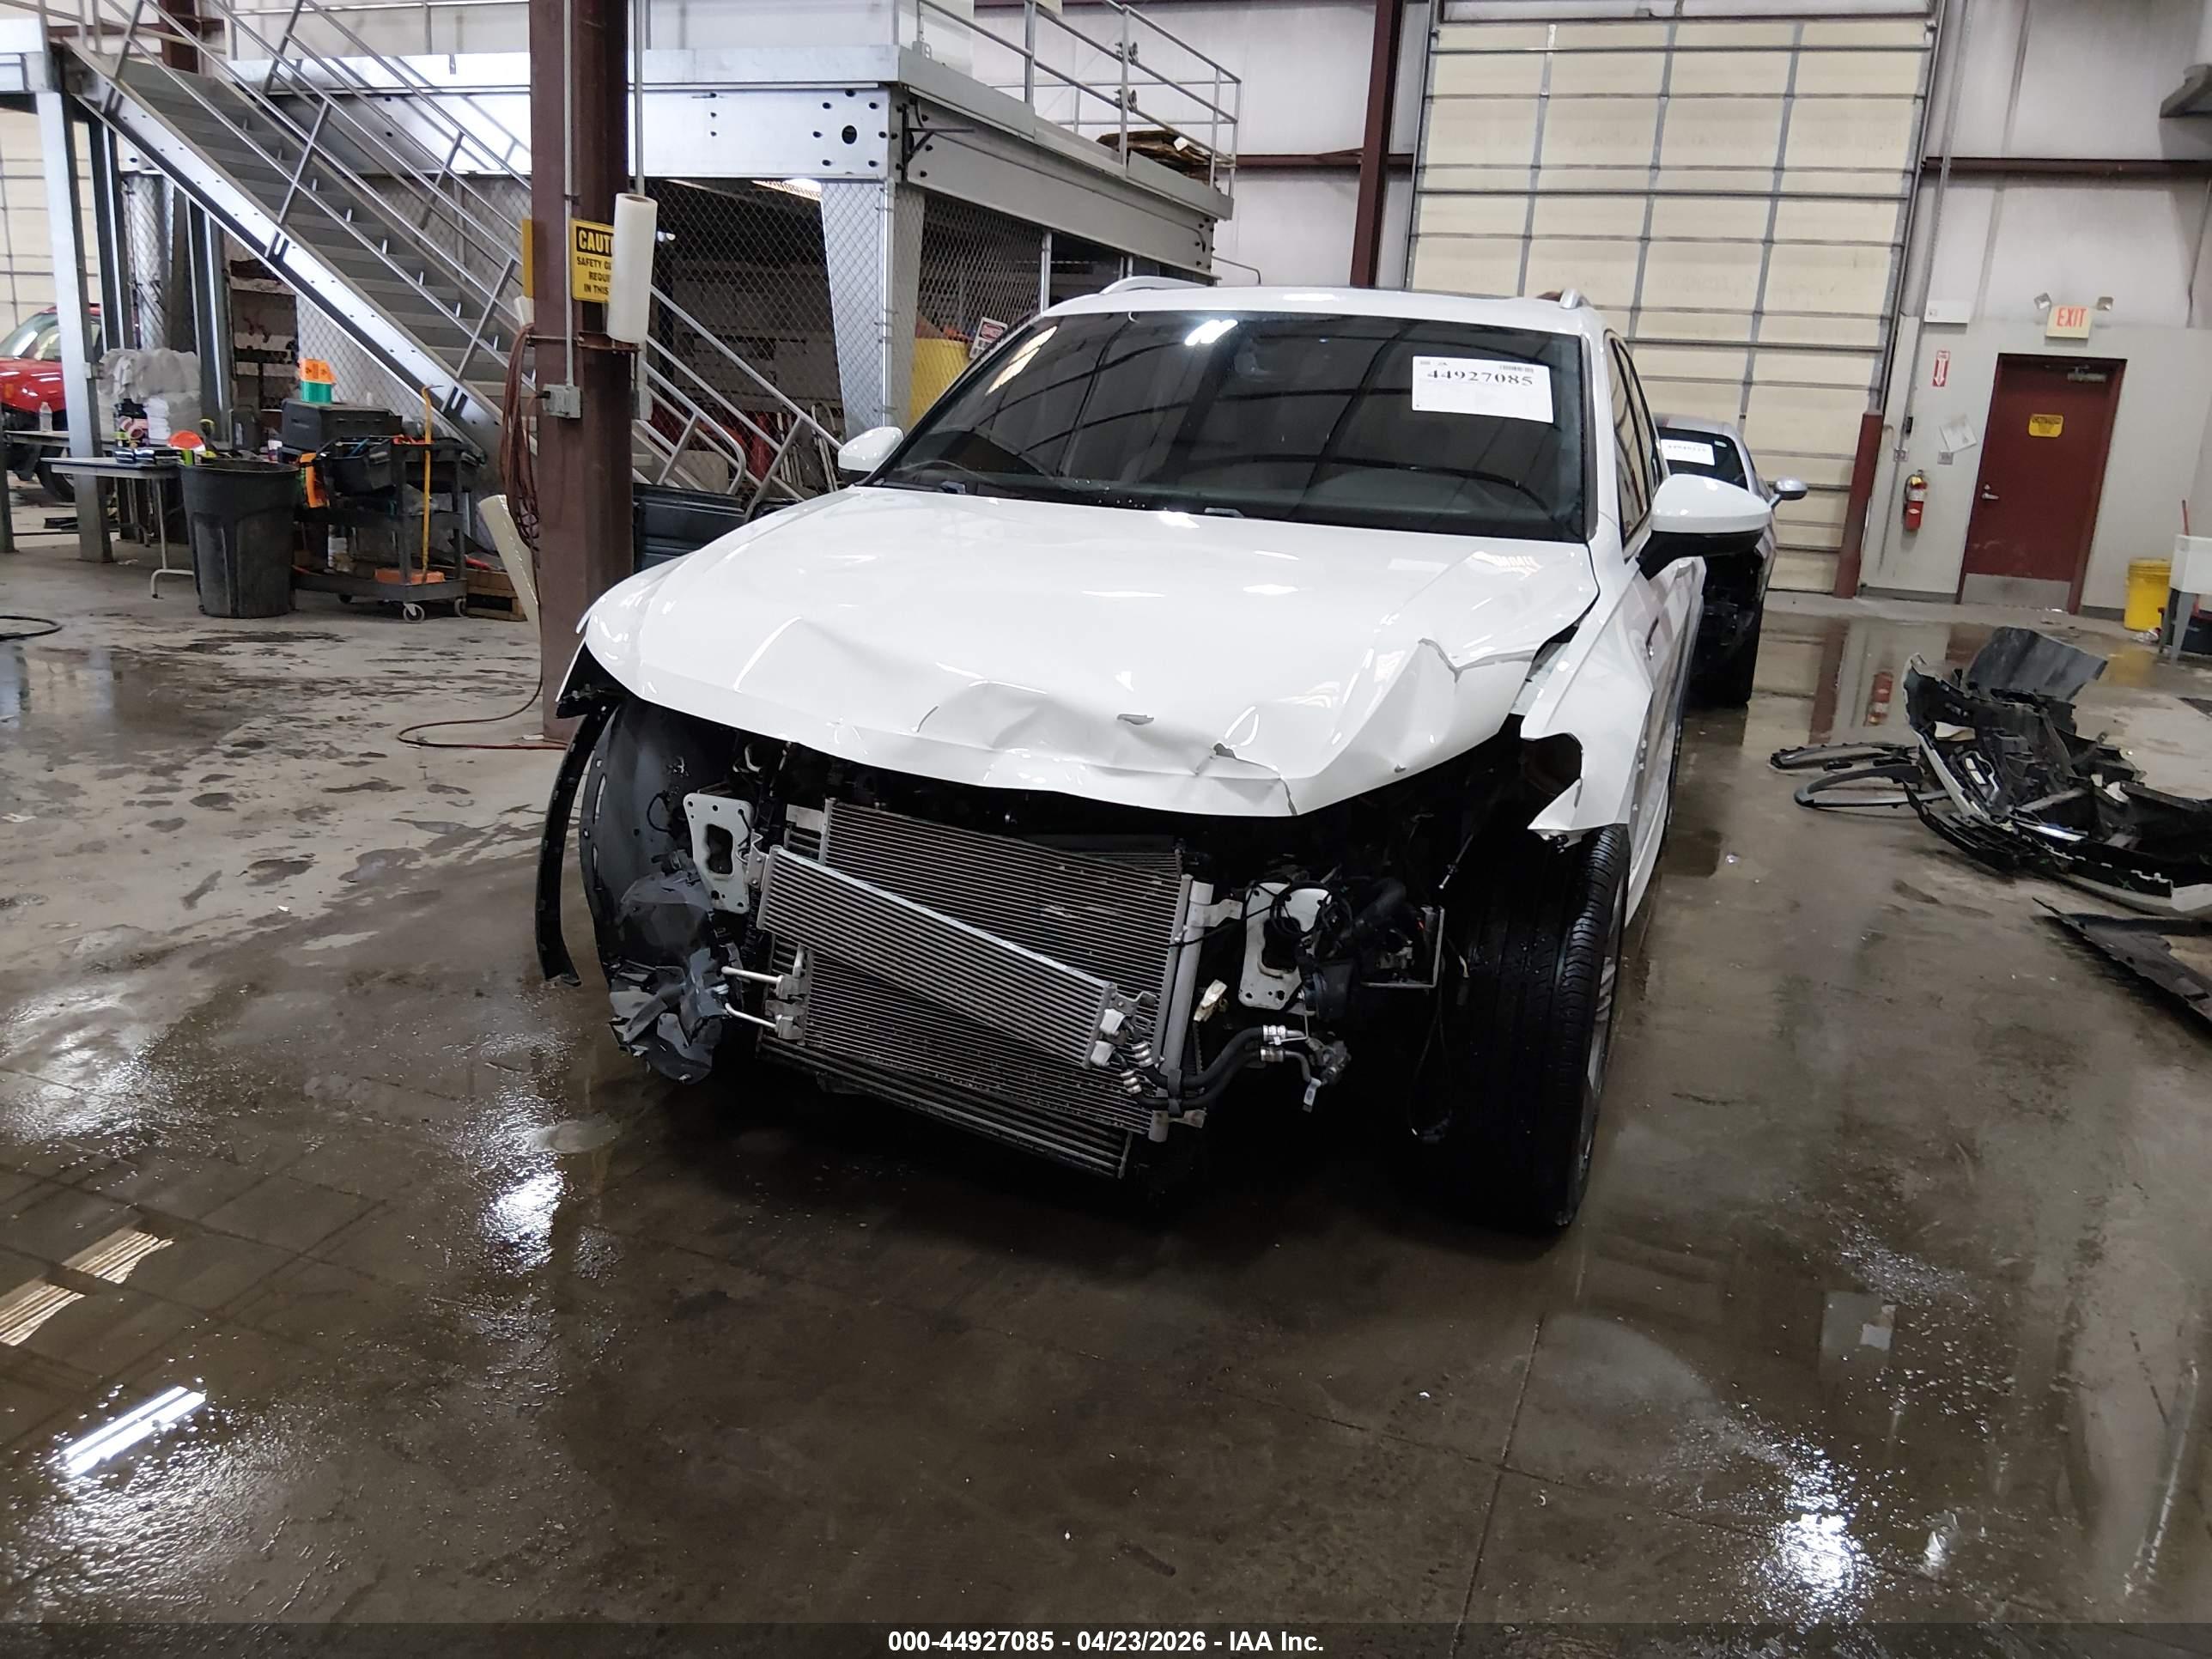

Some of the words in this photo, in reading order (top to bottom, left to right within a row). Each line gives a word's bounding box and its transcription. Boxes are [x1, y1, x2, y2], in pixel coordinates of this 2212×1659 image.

[577, 256, 602, 268] SAFETY
[584, 283, 592, 293] IN
[593, 284, 610, 296] THIS
[2057, 307, 2087, 328] EXIT
[1427, 369, 1534, 386] 44927085
